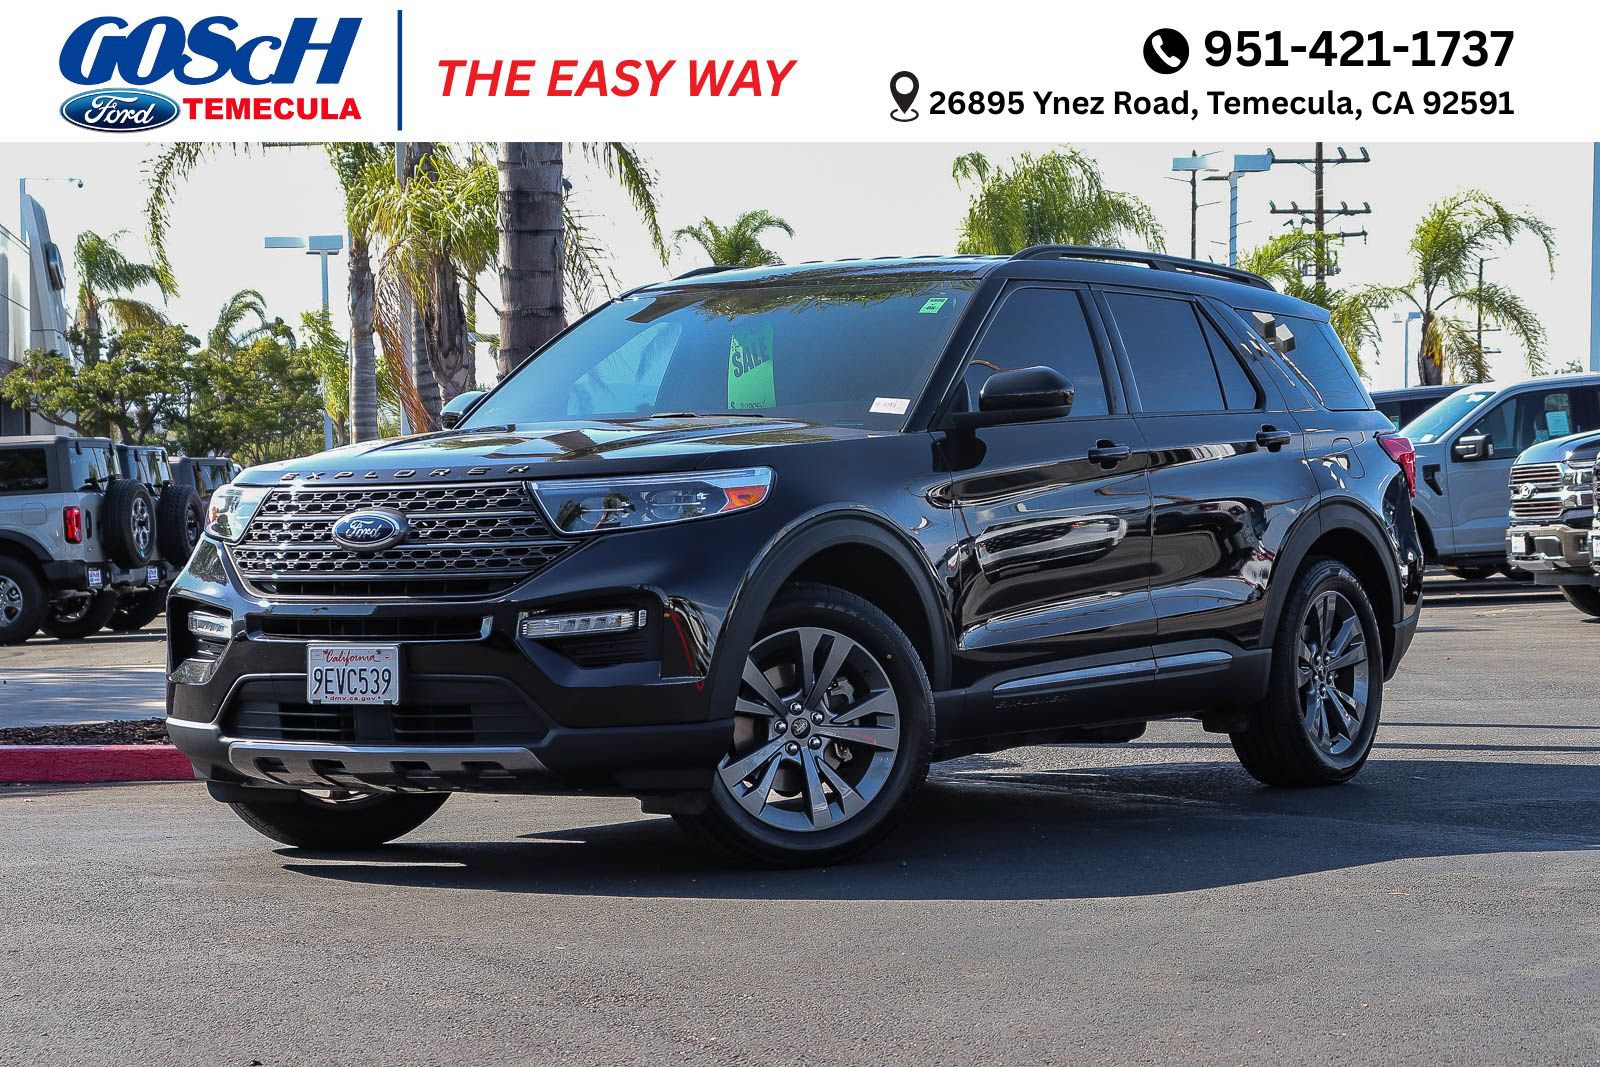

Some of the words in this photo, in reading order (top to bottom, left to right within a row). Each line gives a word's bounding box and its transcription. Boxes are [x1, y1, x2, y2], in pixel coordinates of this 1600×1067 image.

[731, 336, 771, 378] SALE
[280, 464, 530, 482] EXPLORER
[345, 519, 382, 539] Ford
[325, 649, 380, 667] California
[313, 667, 392, 696] 9EVC539
